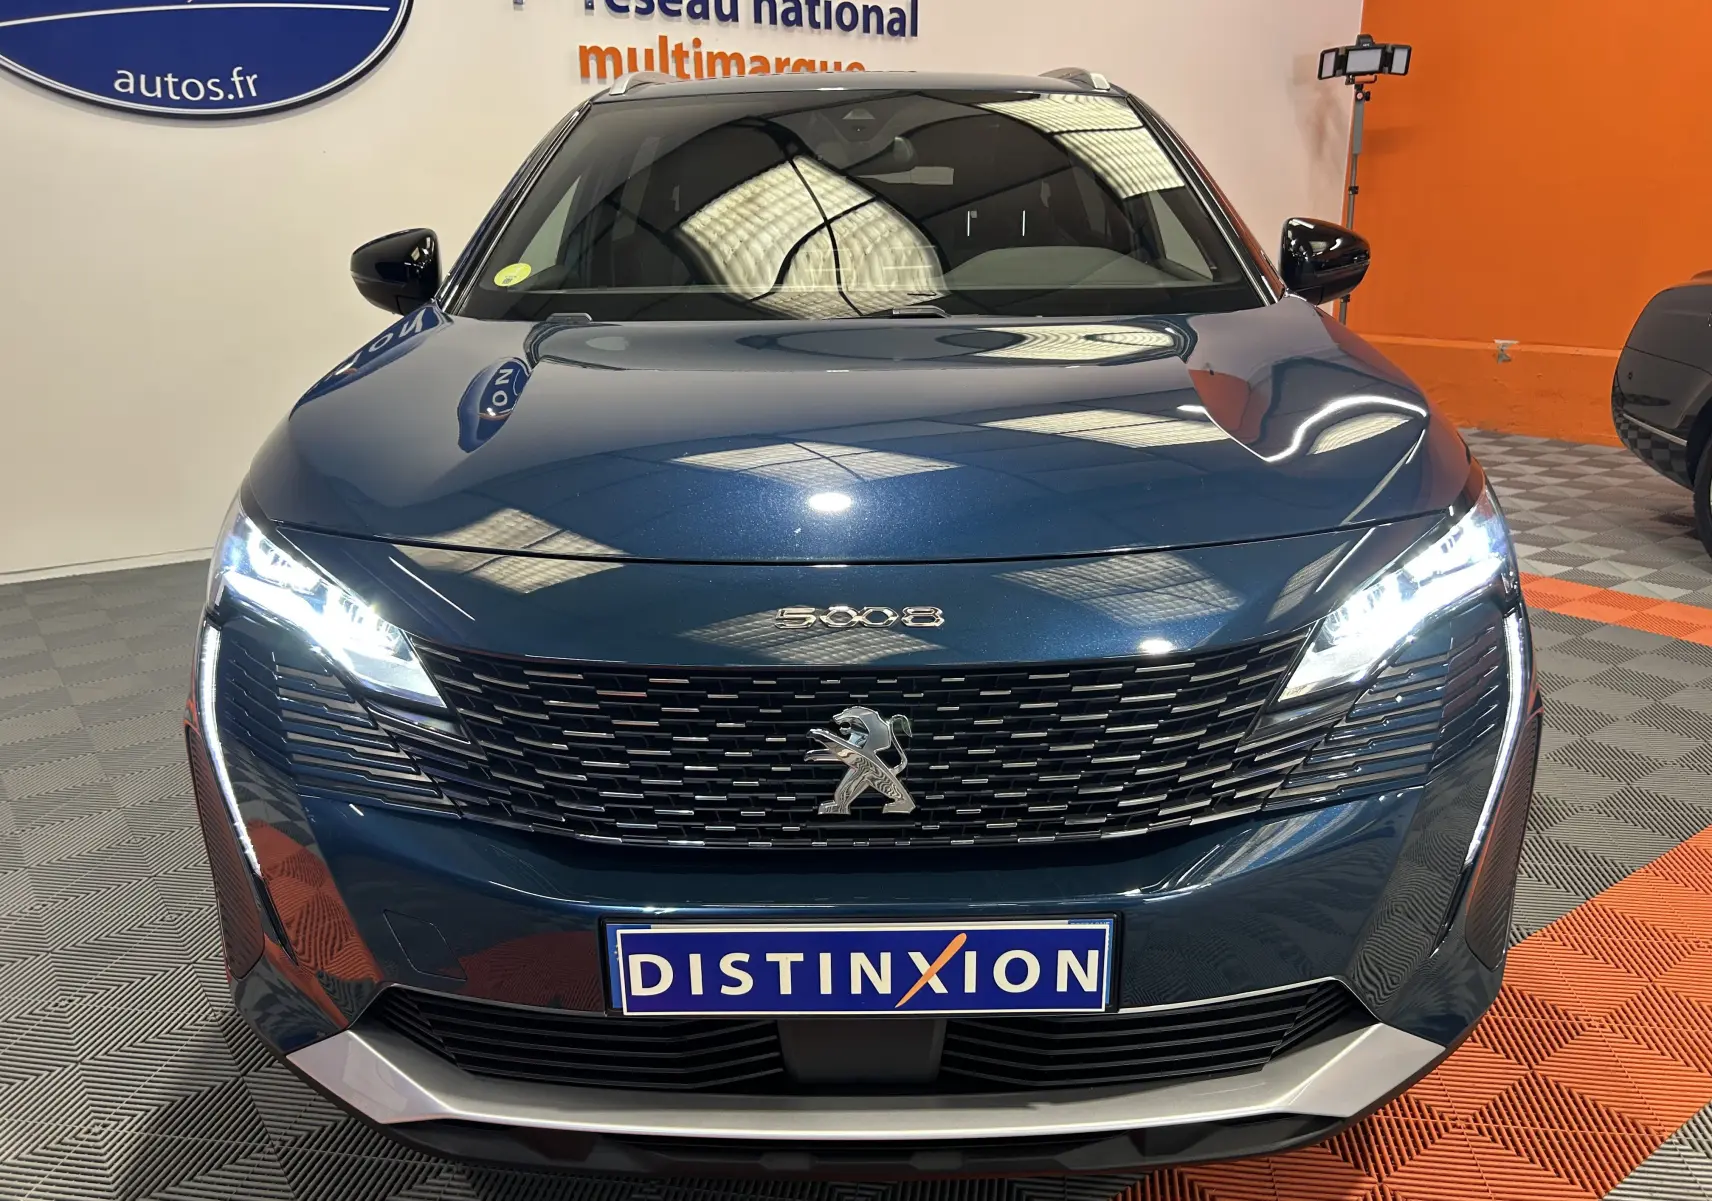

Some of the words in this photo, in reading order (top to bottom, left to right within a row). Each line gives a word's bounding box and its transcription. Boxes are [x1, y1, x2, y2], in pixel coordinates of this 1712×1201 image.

[754, 0, 918, 37] national
[114, 66, 258, 101] autos.fr
[773, 605, 945, 629] 5008
[627, 932, 1100, 1008] DISTINXION
